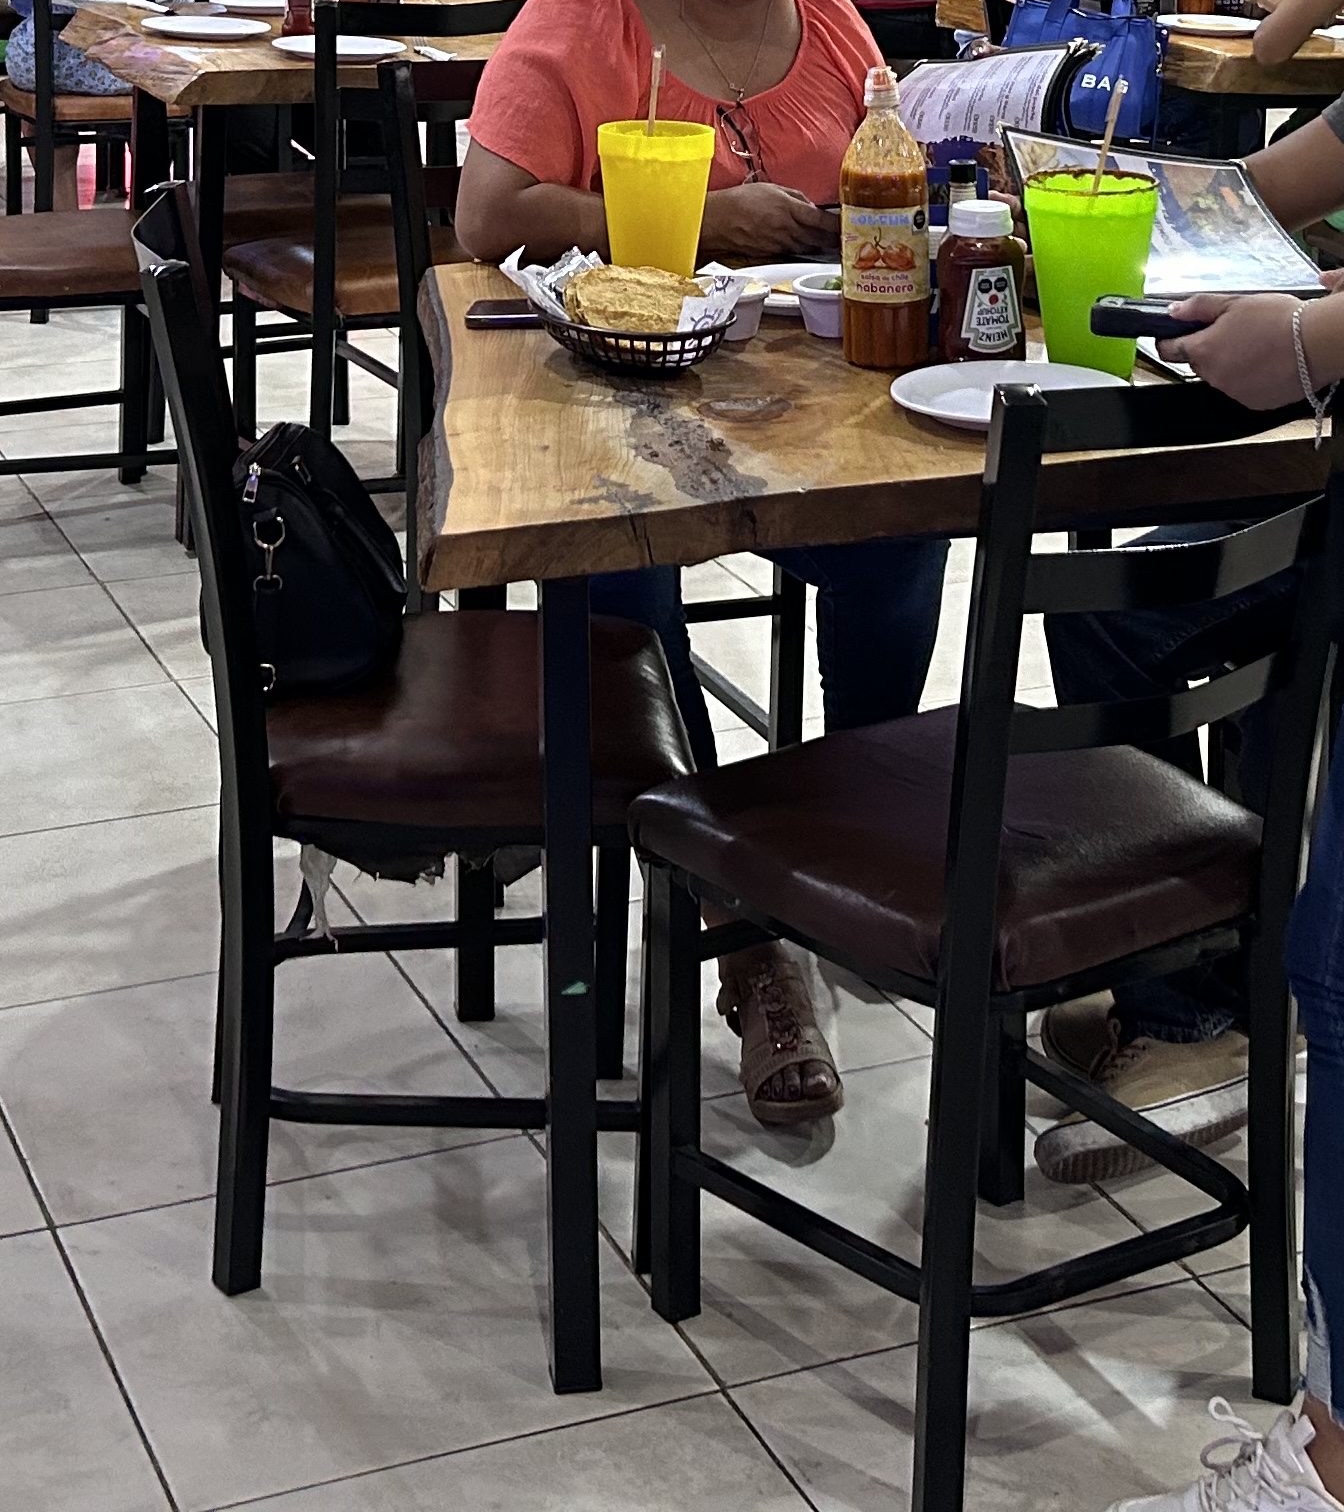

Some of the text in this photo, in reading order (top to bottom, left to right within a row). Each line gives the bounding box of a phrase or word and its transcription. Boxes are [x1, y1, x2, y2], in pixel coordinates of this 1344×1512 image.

[856, 281, 914, 294] habanero
[975, 314, 1010, 327] TOMATE
[978, 330, 1009, 344] HEINZ
